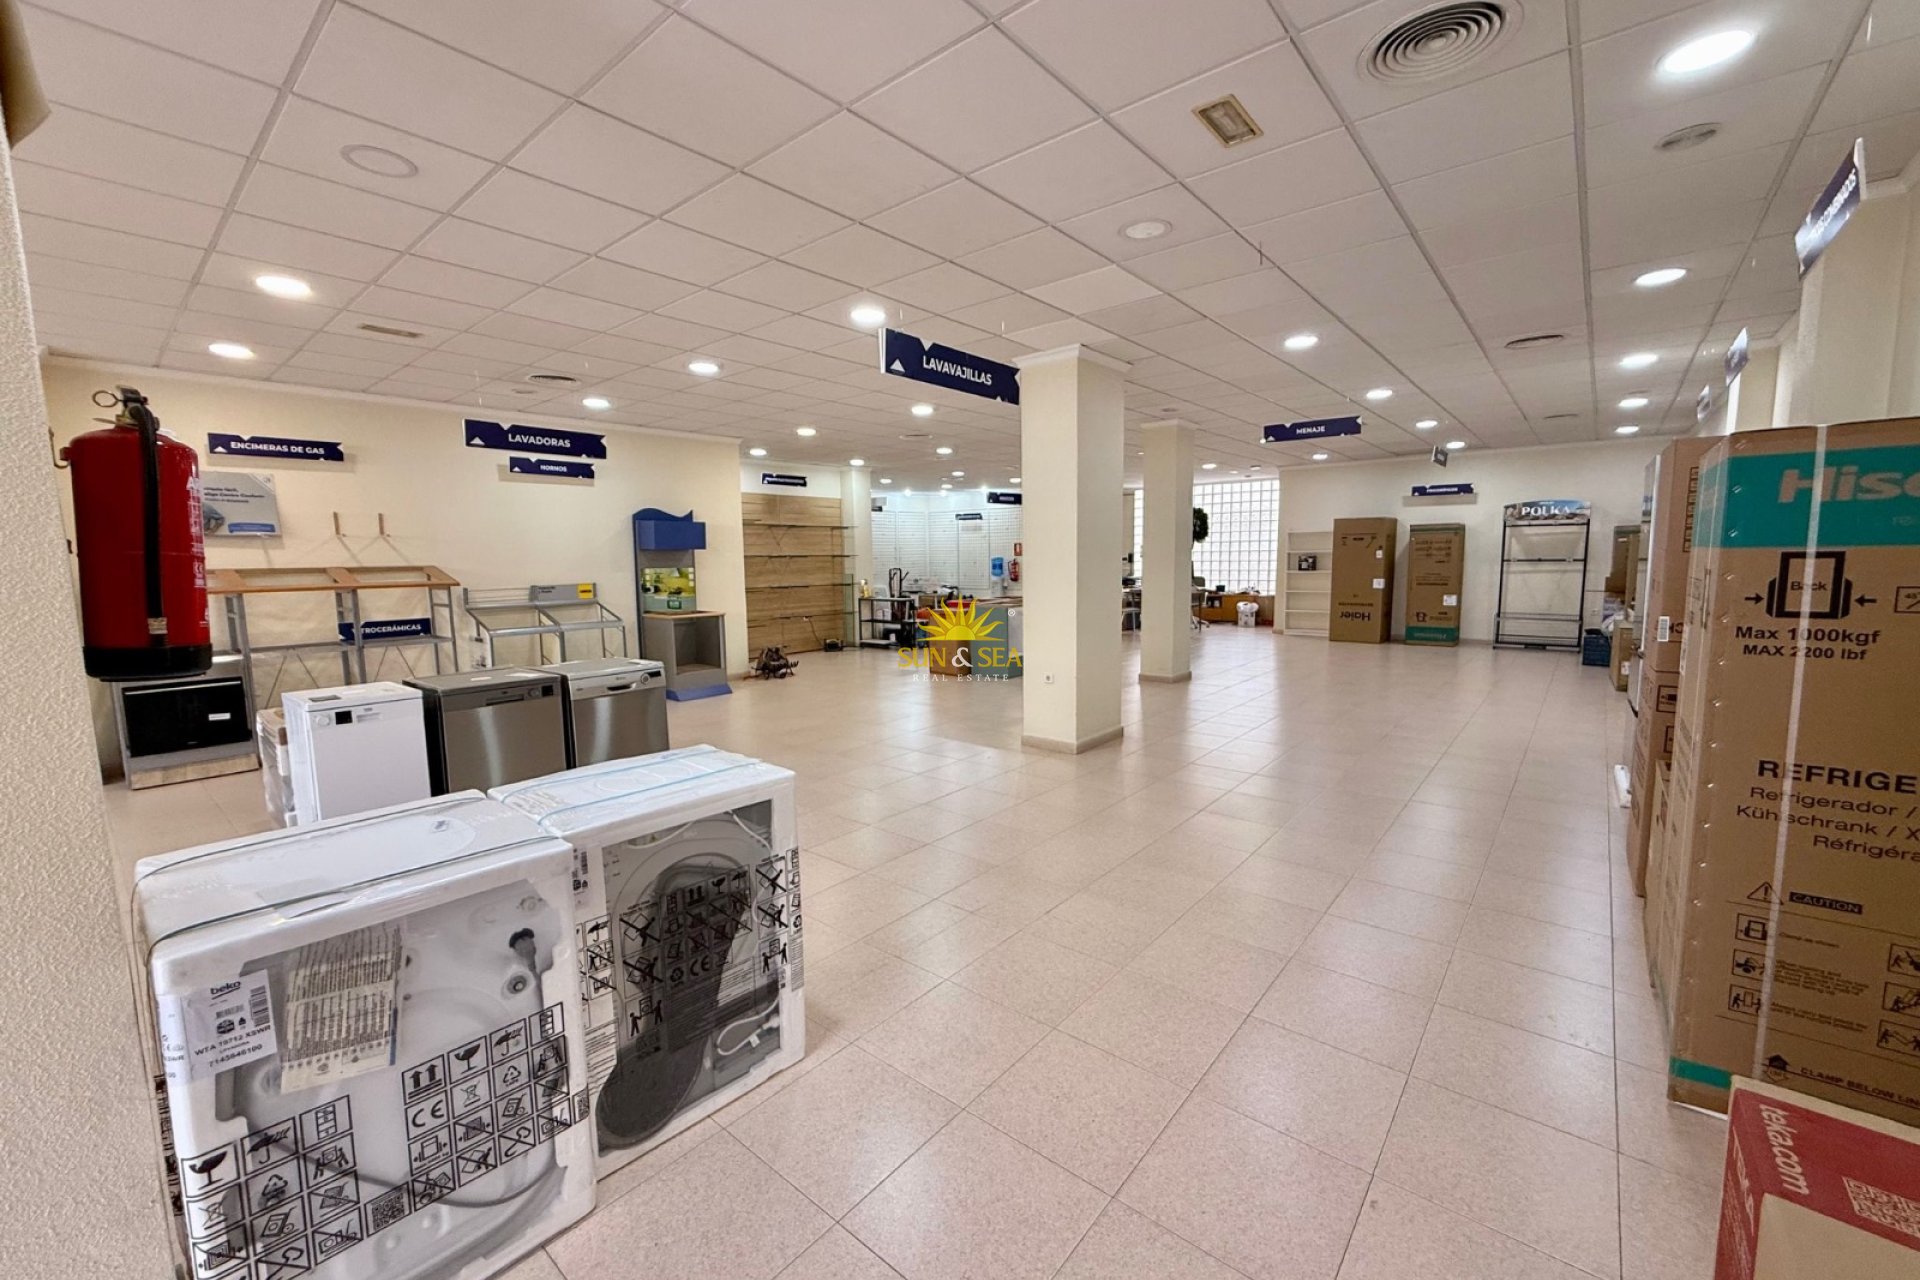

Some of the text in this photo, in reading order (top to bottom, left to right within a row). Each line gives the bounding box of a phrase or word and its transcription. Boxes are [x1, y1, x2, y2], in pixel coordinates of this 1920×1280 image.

[922, 355, 992, 386] LAVAVAJILLAS
[1296, 425, 1326, 435] MENAJE
[508, 433, 571, 448] LAVADORAS
[230, 441, 325, 455] ENCIMERAS DE GAS
[540, 464, 567, 473] HORNOS
[1521, 505, 1571, 516] POLKA
[1790, 581, 1828, 591] Bck
[1340, 611, 1371, 621] Haier
[352, 623, 422, 634] VTROCERÁMICAS
[1735, 626, 1779, 640] Max
[1743, 644, 1785, 657] MAX
[1840, 648, 1867, 660] lbf
[1736, 805, 1878, 835] Kühschrank
[1792, 892, 1859, 913] CAUTION
[210, 981, 241, 995] beko
[194, 1044, 216, 1056] WTA
[1801, 1067, 1843, 1083] CLAMP
[1847, 1080, 1895, 1098] BELOW
